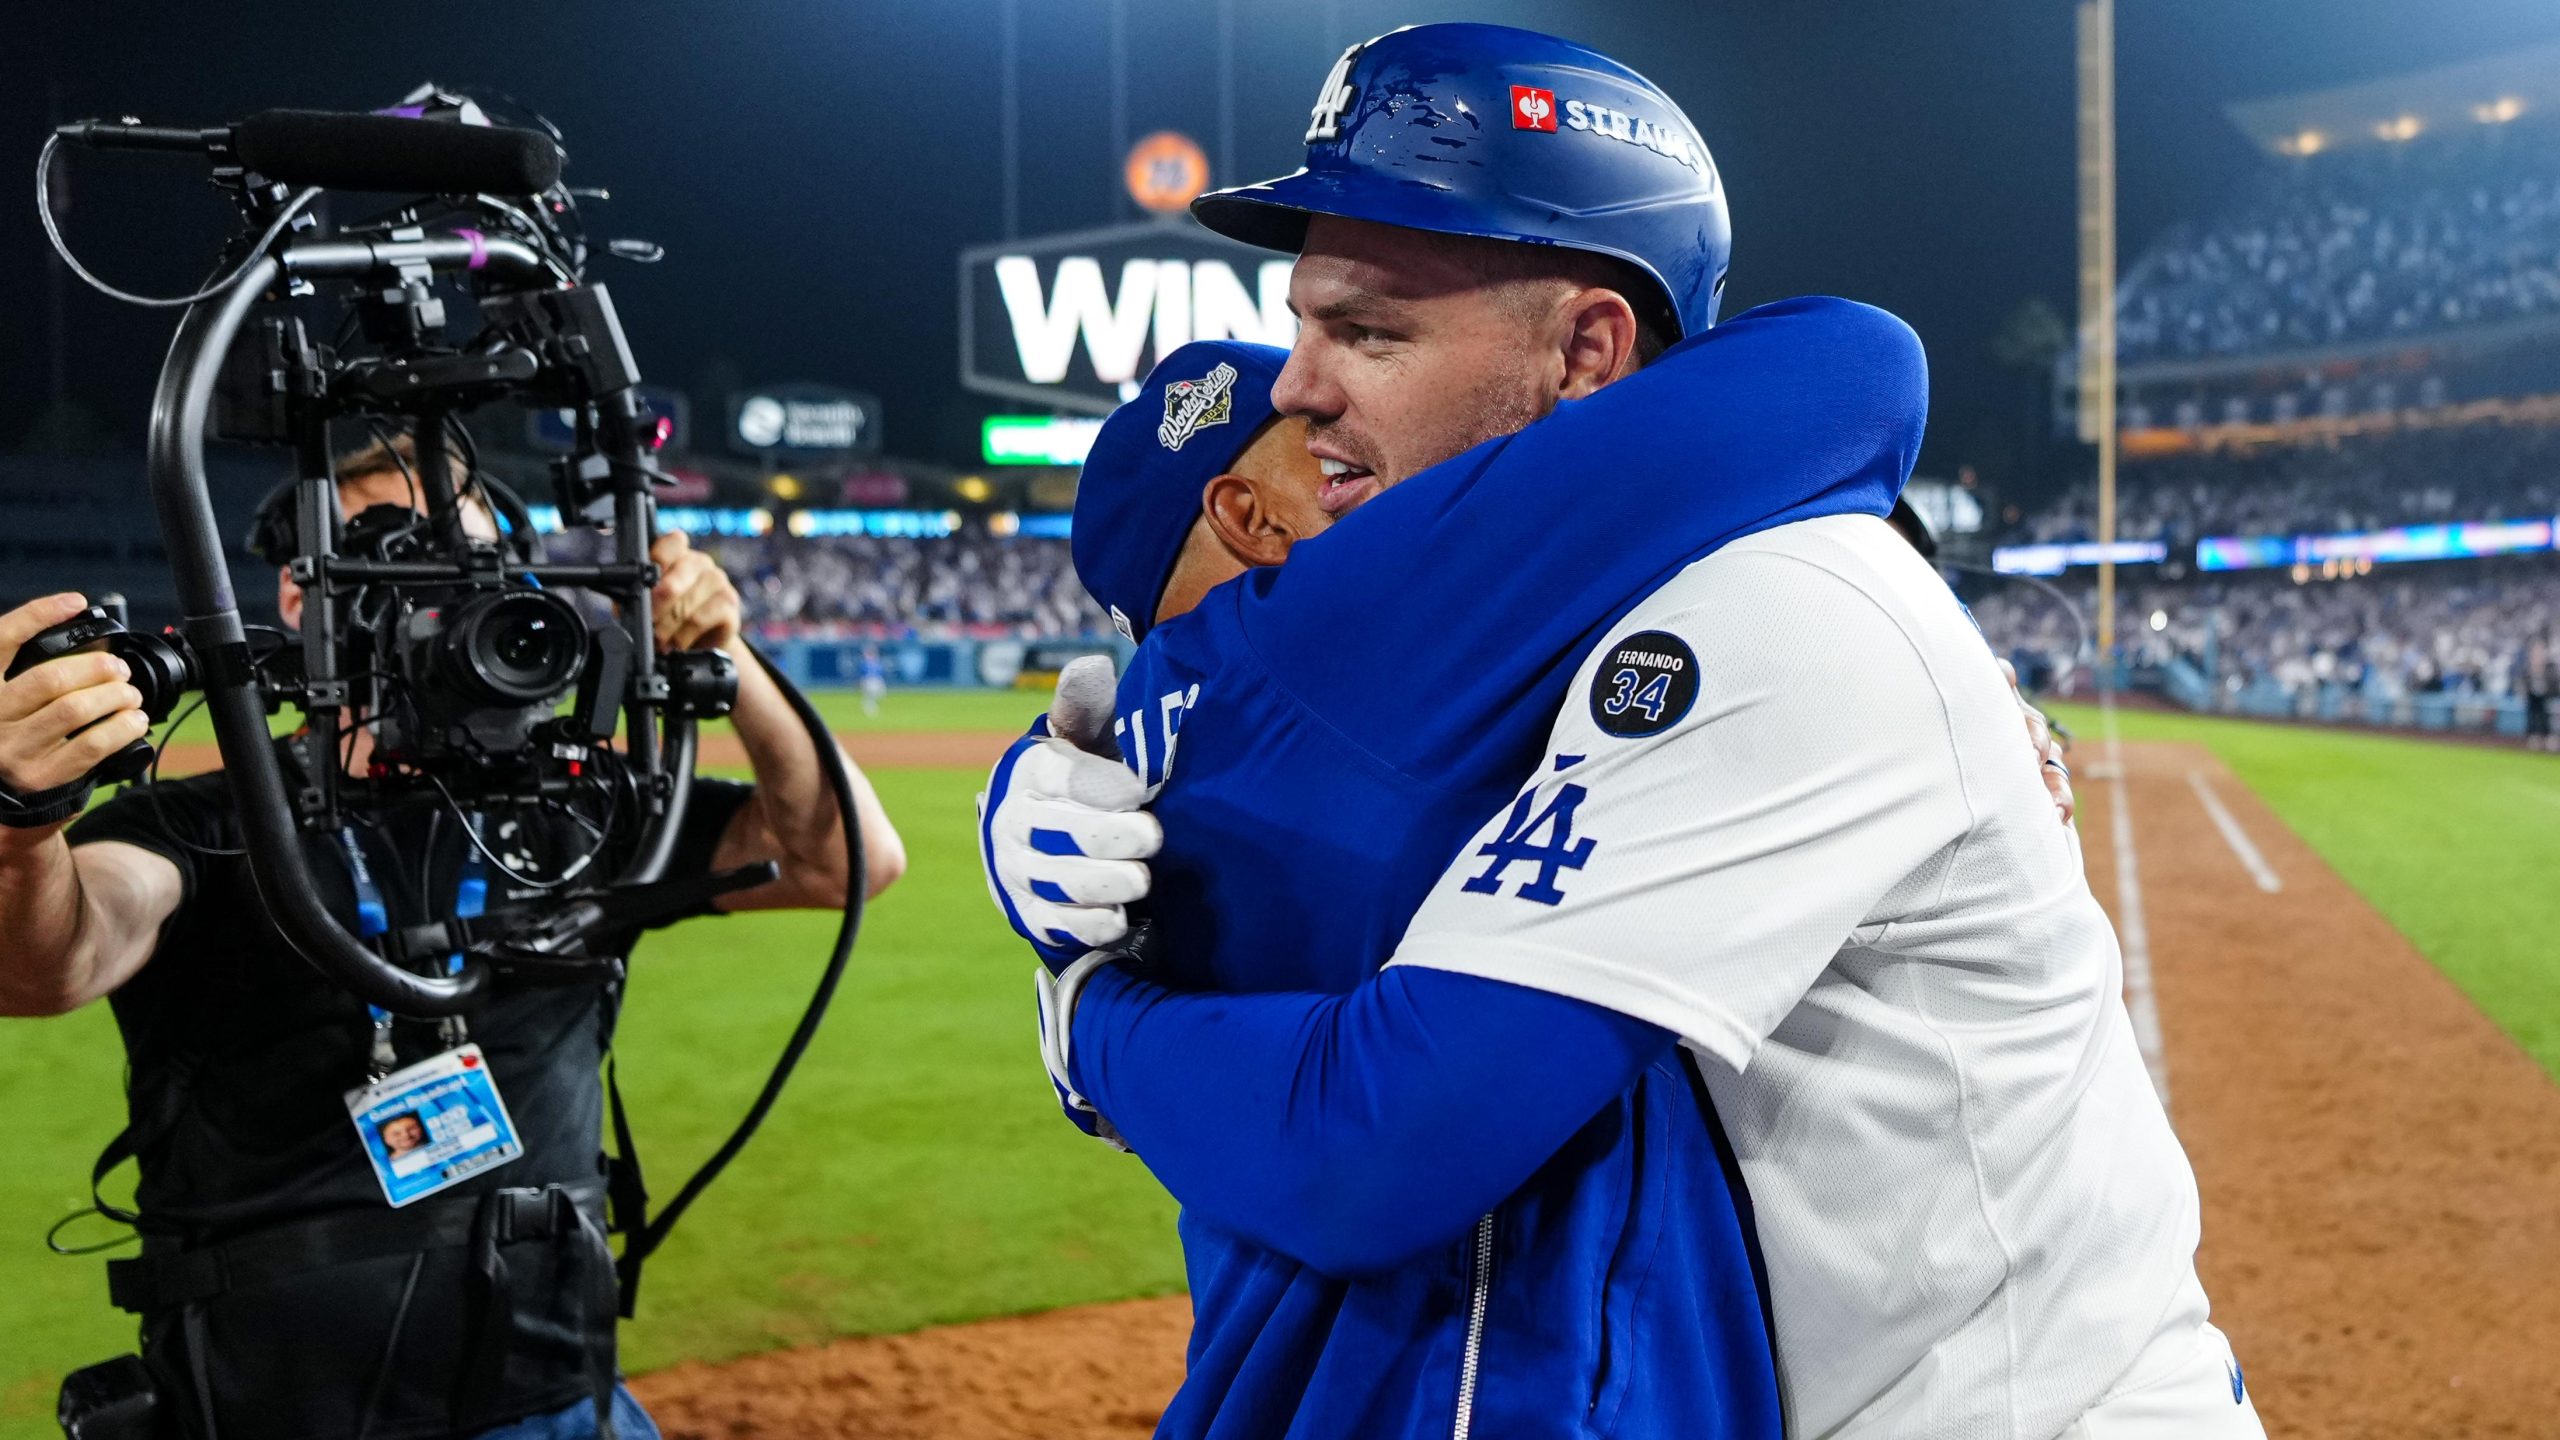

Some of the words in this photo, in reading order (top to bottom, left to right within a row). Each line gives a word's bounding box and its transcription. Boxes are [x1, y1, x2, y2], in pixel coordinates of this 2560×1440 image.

[995, 255, 1301, 384] WIN
[1159, 390, 1202, 448] World
[1192, 365, 1235, 410] Series
[1604, 668, 1672, 722] 34
[1616, 650, 1684, 672] FERNANDO
[1460, 753, 1598, 907] LA
